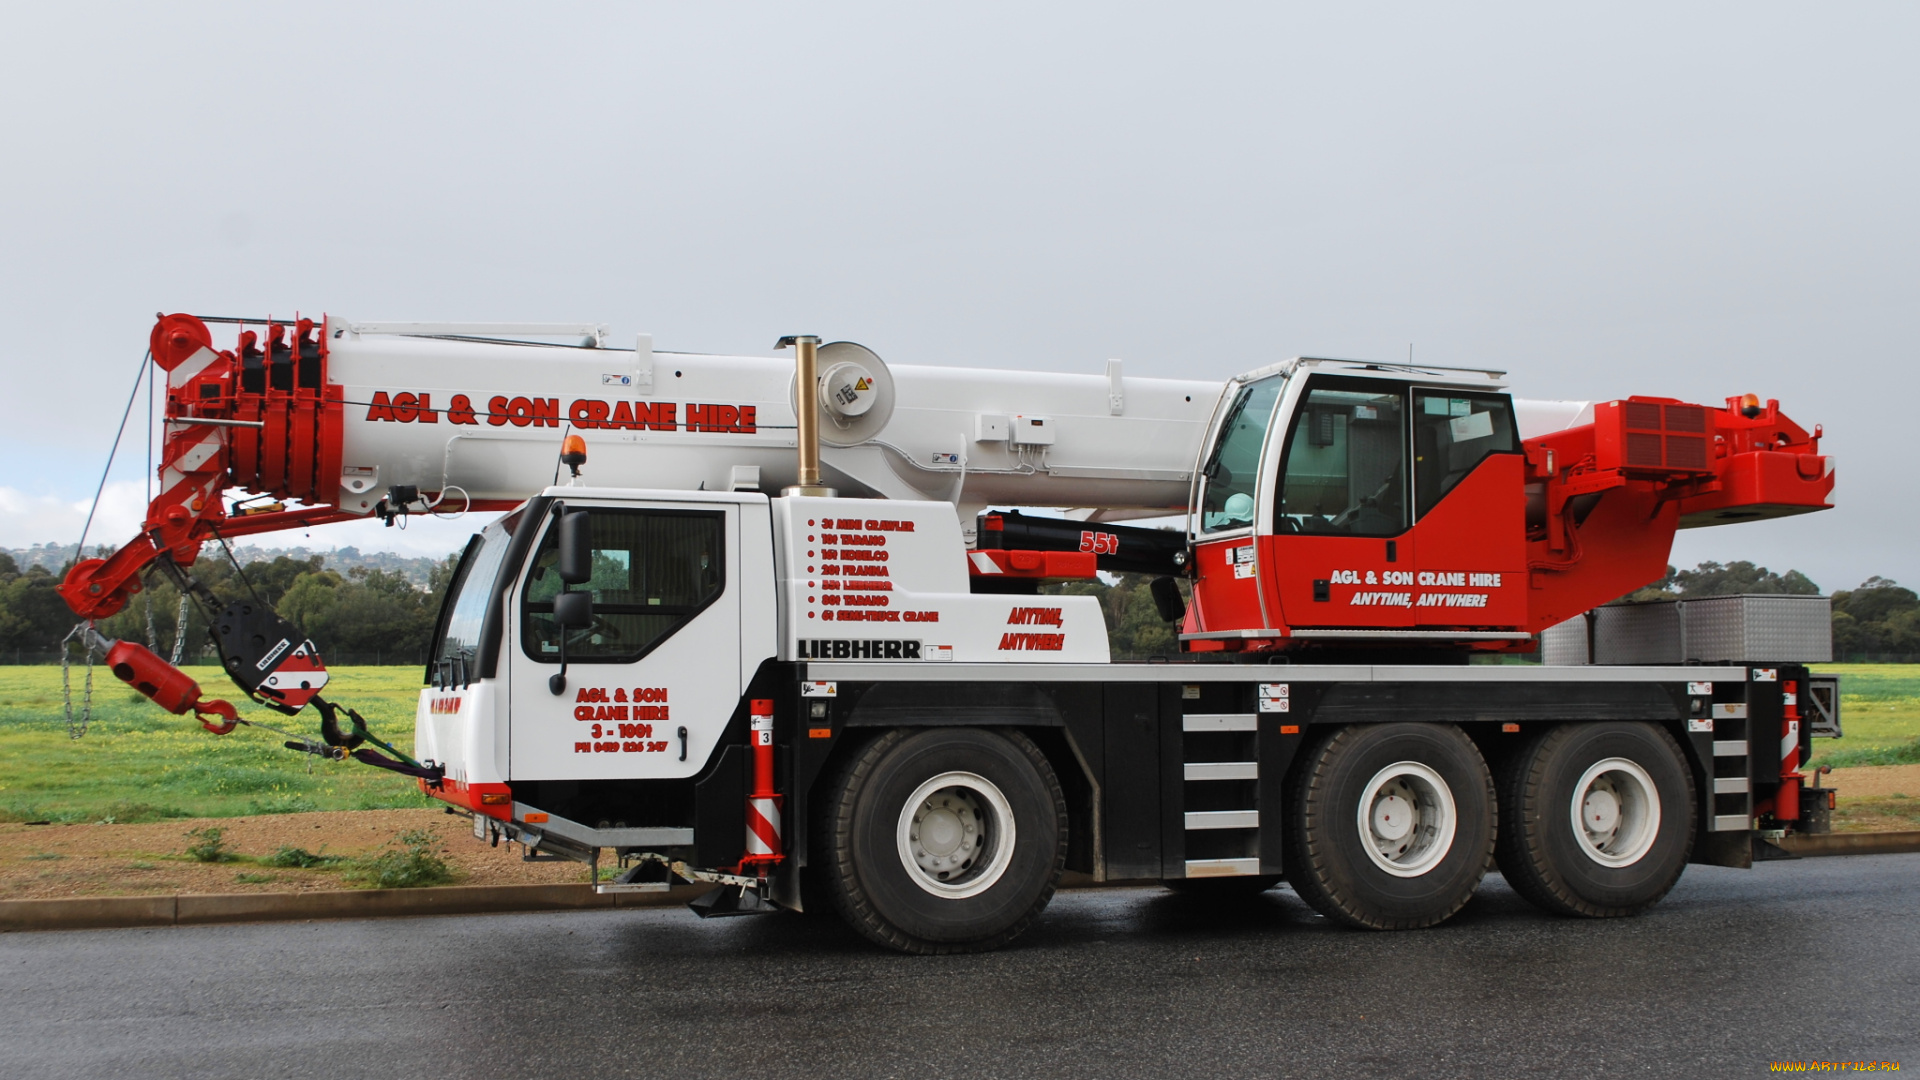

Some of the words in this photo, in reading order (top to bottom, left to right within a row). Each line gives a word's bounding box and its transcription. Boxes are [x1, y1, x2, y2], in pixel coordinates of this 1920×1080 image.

[366, 391, 438, 423] AGL
[447, 394, 478, 424] &
[487, 396, 560, 427] SON
[569, 399, 677, 431] CRANE
[686, 404, 757, 433] HIRE
[821, 518, 834, 529] 3t
[836, 518, 863, 530] MINI
[865, 519, 915, 532] CRAWLER
[821, 533, 839, 545] 10t
[840, 534, 887, 547] TADANO
[1079, 530, 1119, 556] 55t
[821, 549, 838, 560] 16t
[840, 549, 890, 562] KOBELCO
[821, 564, 841, 576] 20t
[842, 564, 890, 577] FRANNA
[822, 579, 841, 591] 55t
[843, 580, 893, 591] LIEBHERR
[1330, 570, 1361, 584] AGL
[1365, 571, 1377, 584] &
[1383, 571, 1413, 585] SON
[1418, 572, 1465, 586] CRANE
[1470, 573, 1501, 586] HIRE
[843, 594, 890, 607] TADANO
[1351, 592, 1412, 608] ANYTIME,
[1416, 594, 1488, 607] ANYWHERE
[837, 610, 901, 622] SEMI-TRUCK
[902, 611, 939, 623] CRANE
[998, 632, 1066, 651] ANYWHERE
[798, 640, 920, 658] LIEBHERR
[576, 687, 611, 703] AGL
[614, 687, 628, 703] &
[633, 687, 668, 703] SON
[574, 705, 630, 721] CRANE
[632, 705, 670, 721] HIRE
[591, 723, 603, 739] 3
[618, 723, 653, 739] 100t
[1792, 723, 1797, 731] 4
[763, 732, 770, 744] 3
[575, 742, 592, 753] PH
